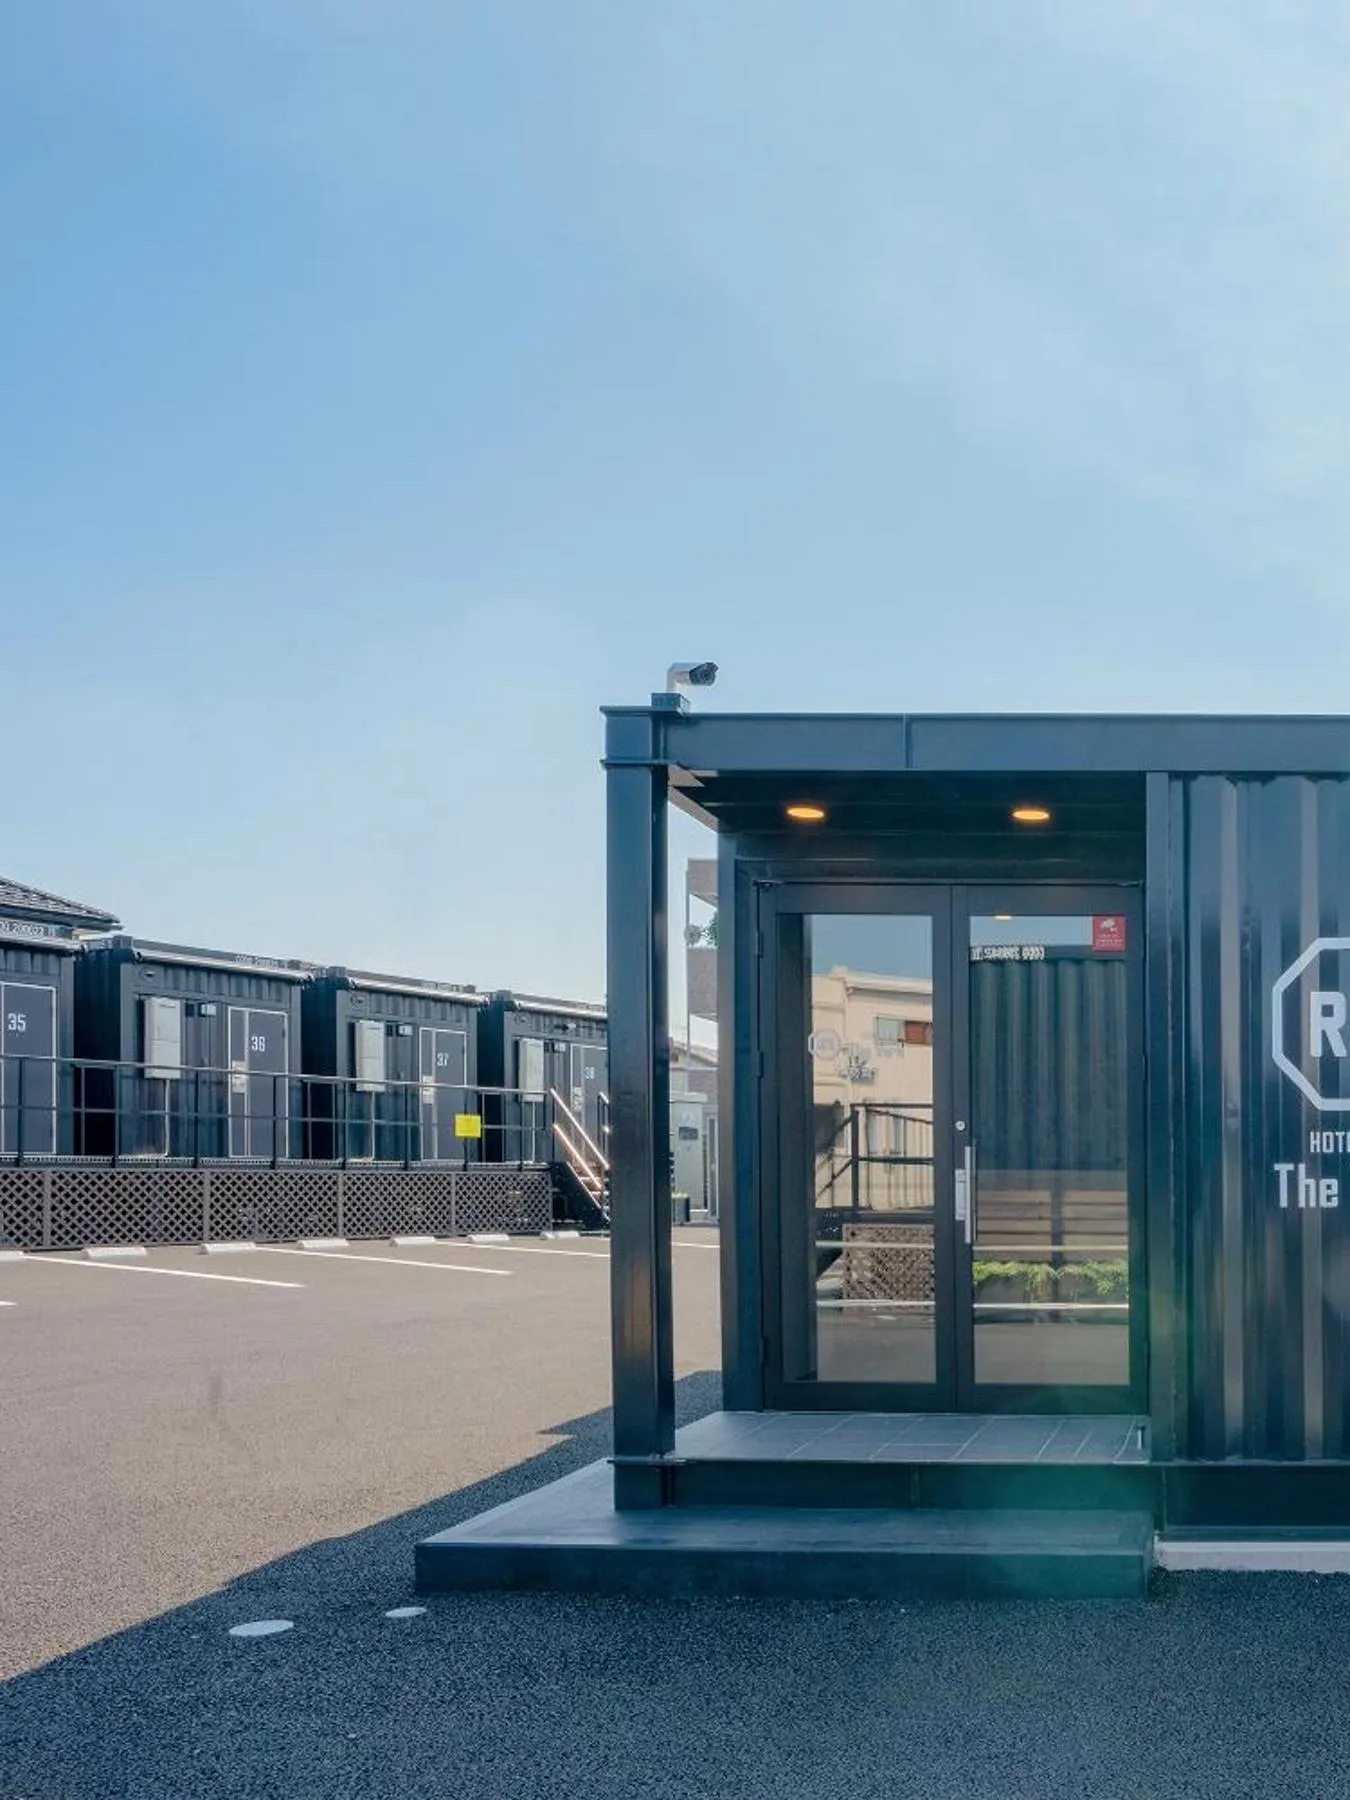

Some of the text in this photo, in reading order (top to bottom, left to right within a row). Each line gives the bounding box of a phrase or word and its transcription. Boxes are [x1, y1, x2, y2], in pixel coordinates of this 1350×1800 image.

[8, 1013, 26, 1032] 35
[436, 1053, 449, 1067] 37
[1273, 1163, 1339, 1209] The
